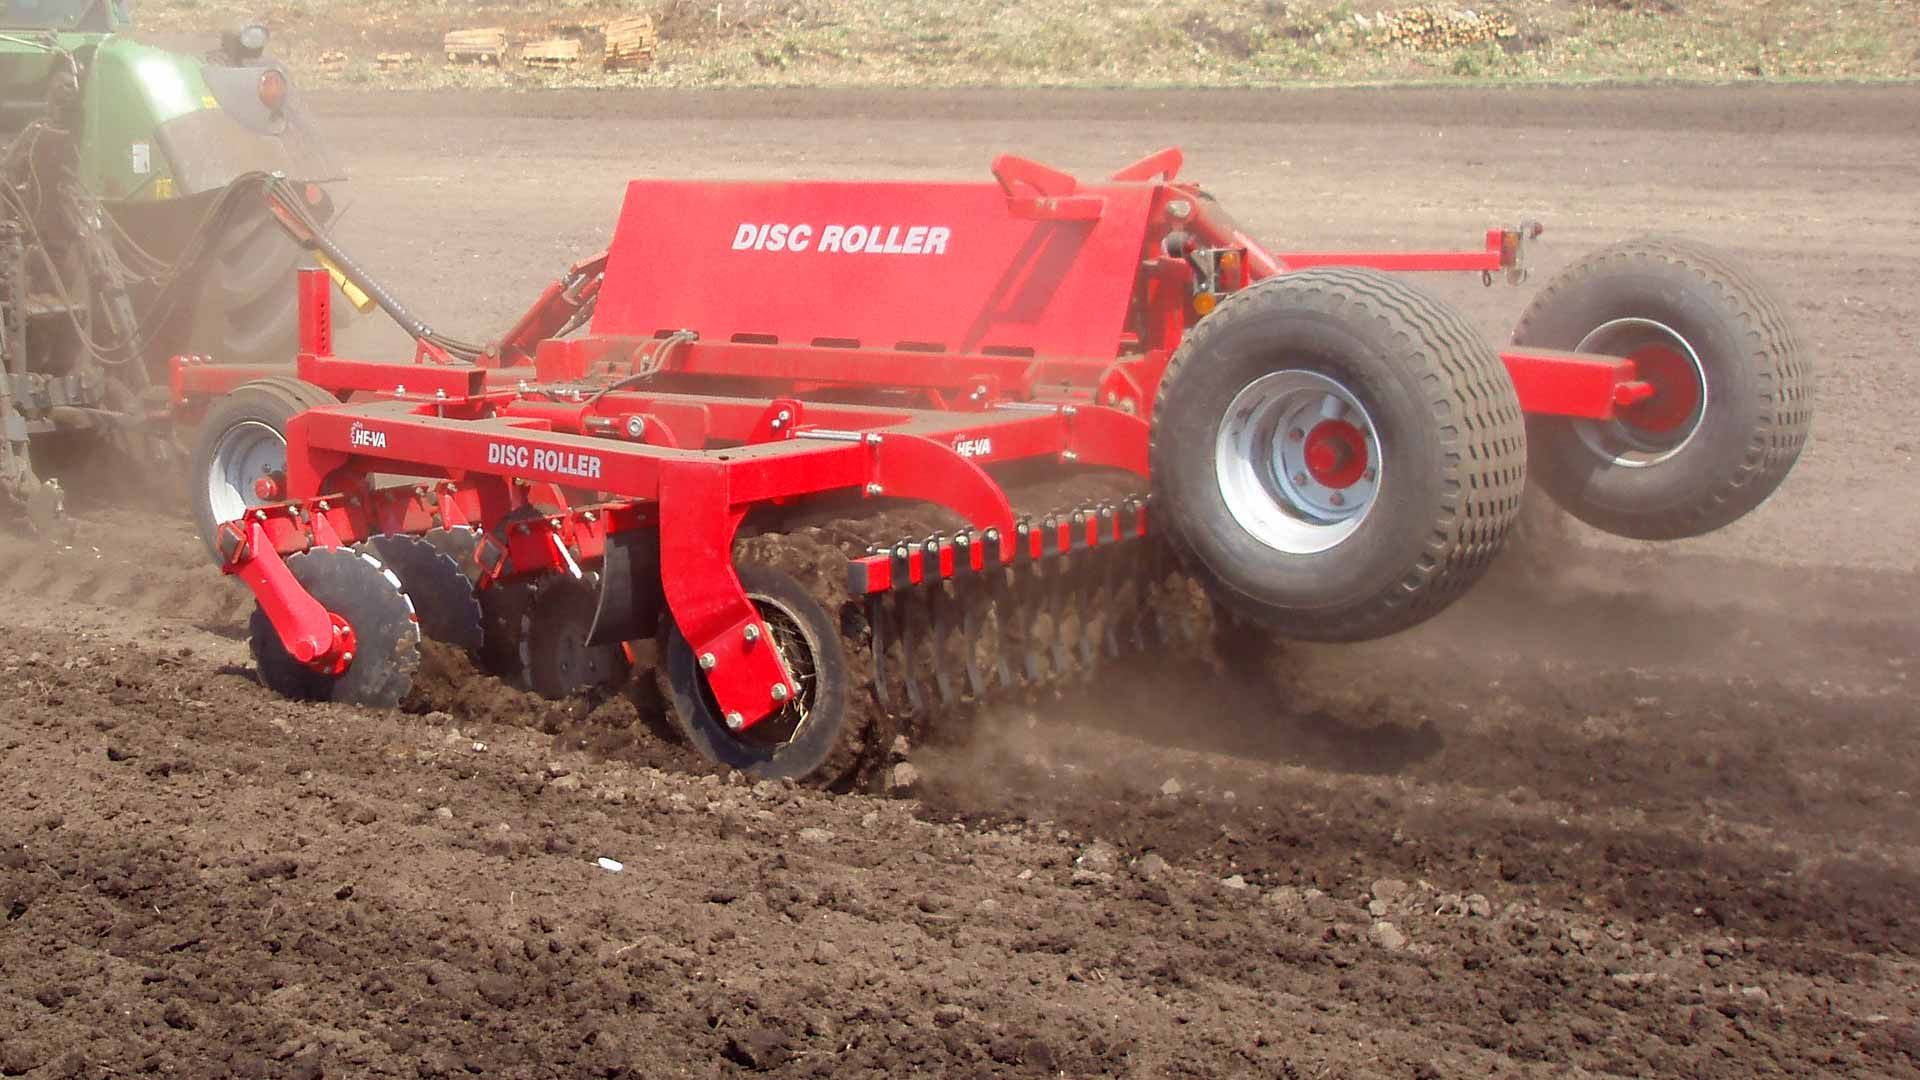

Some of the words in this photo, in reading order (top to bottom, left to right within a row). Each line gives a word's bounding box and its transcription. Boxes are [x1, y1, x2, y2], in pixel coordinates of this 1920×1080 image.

[732, 223, 812, 252] DISC
[817, 224, 951, 255] ROLLER
[354, 430, 387, 448] HE-VA
[956, 437, 992, 457] HE-VA
[487, 443, 529, 468] DISC
[533, 447, 602, 478] ROLLER
